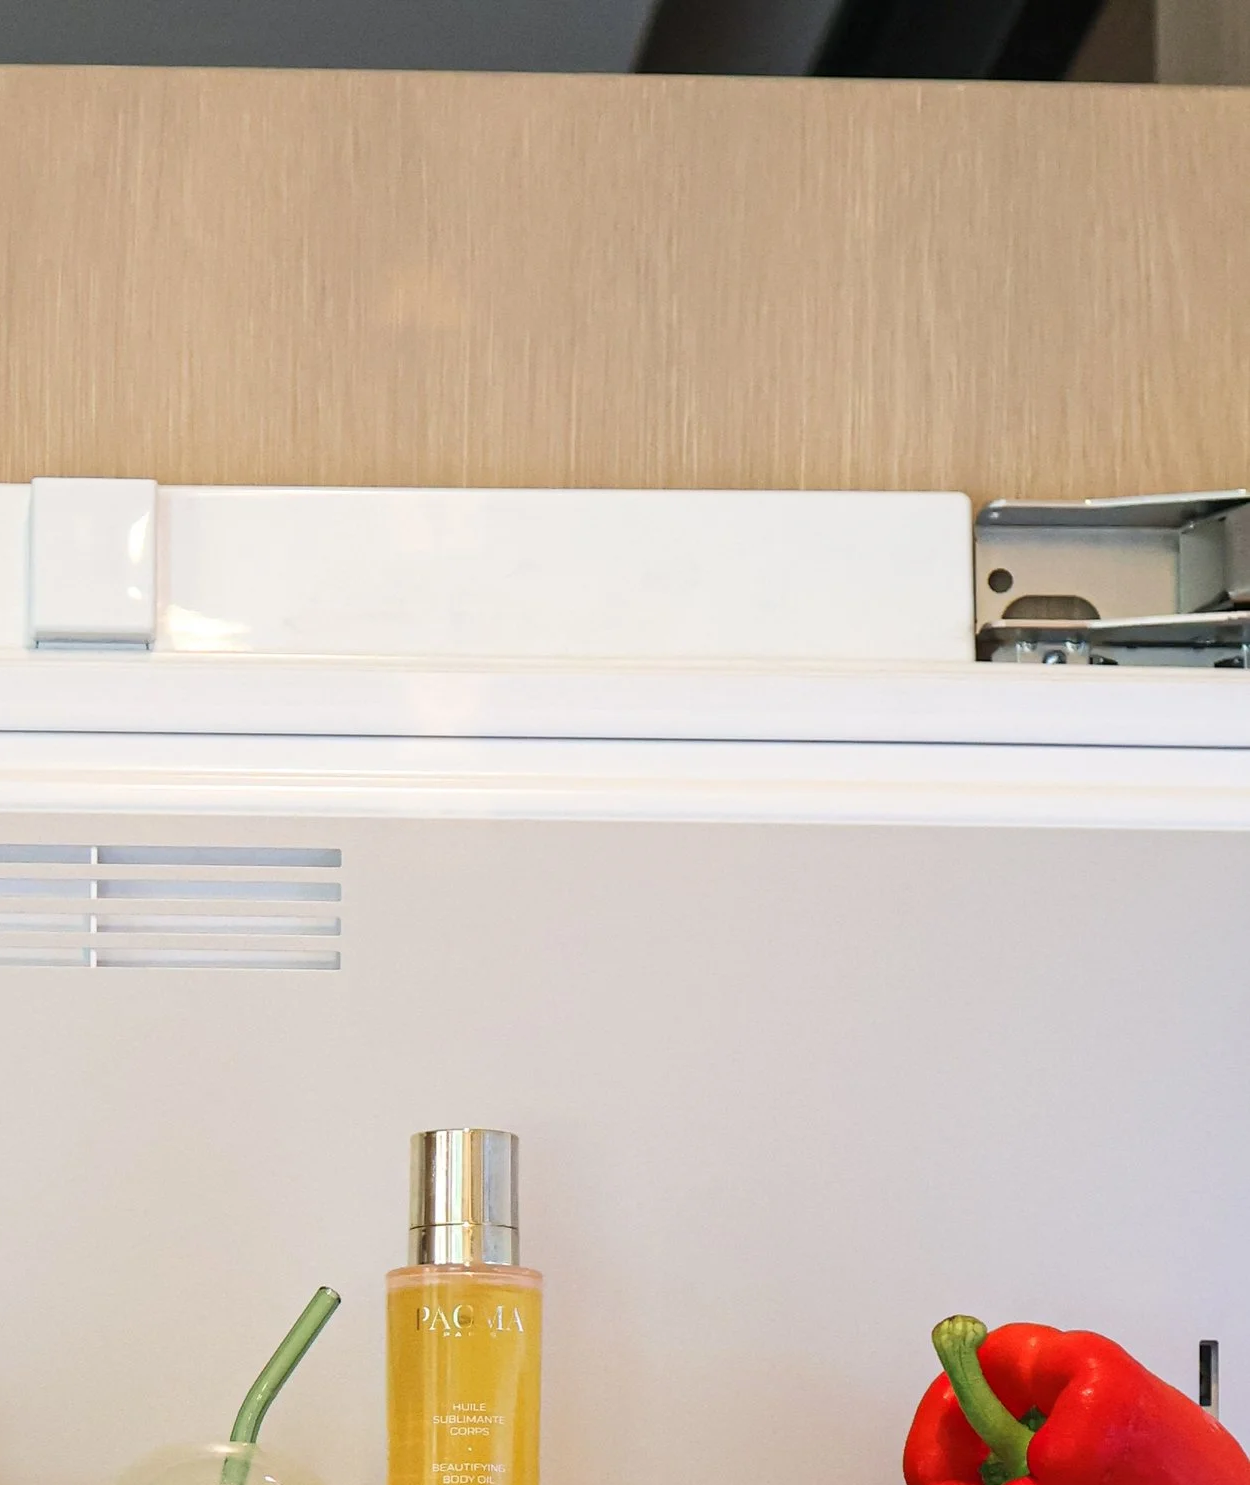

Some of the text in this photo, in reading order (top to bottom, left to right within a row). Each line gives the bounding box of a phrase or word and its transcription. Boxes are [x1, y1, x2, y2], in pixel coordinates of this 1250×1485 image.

[452, 1403, 487, 1412] HUILE
[432, 1415, 506, 1425] SUBLIMANTE
[450, 1427, 490, 1436] CORPS
[432, 1463, 506, 1473] BEAUTIFYING
[442, 1475, 496, 1485] BODY OIL
